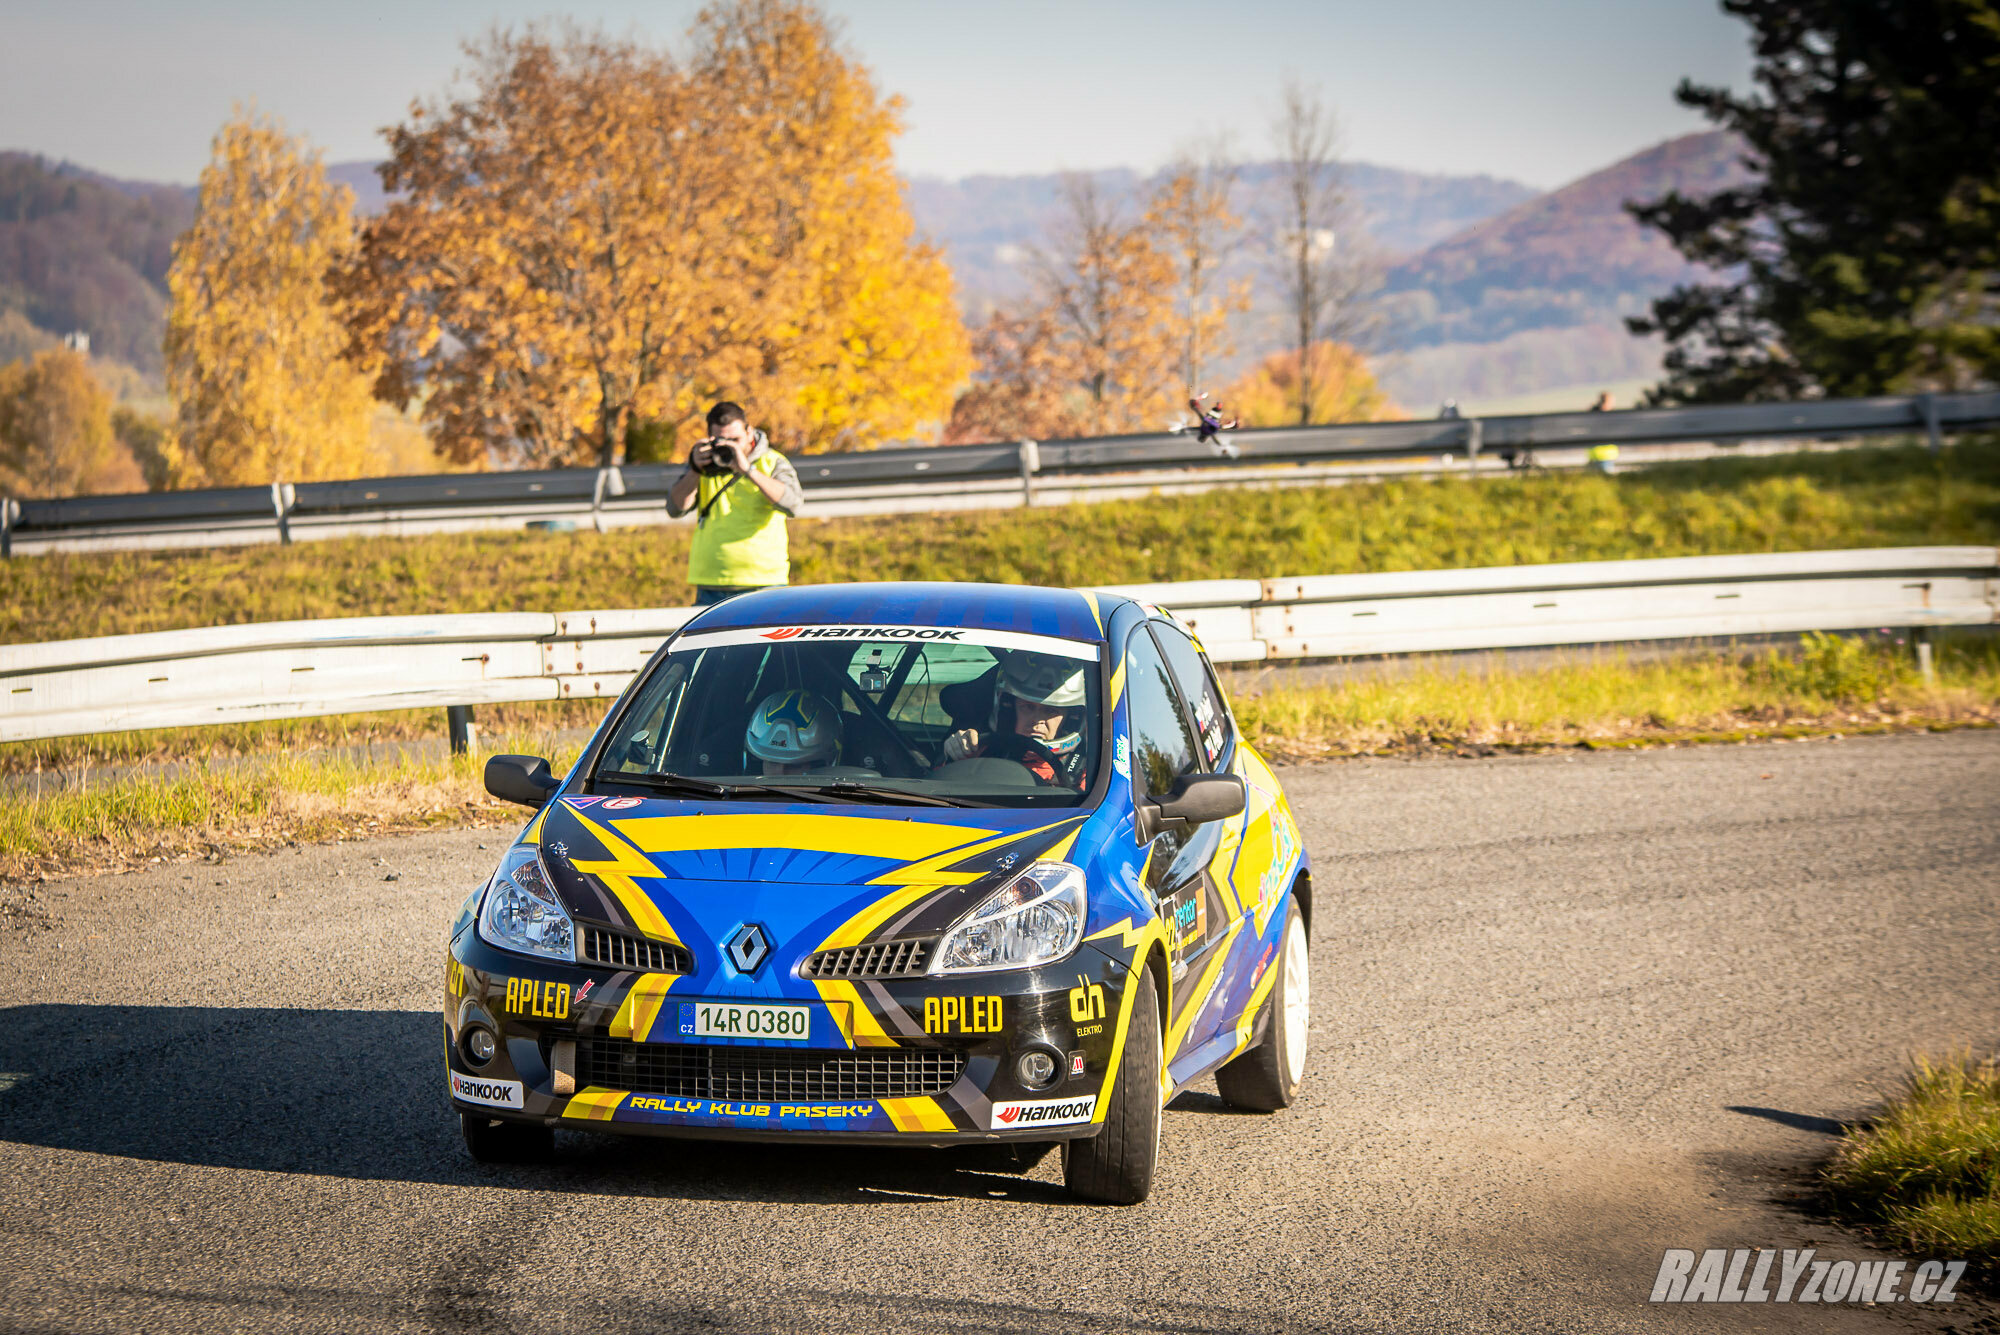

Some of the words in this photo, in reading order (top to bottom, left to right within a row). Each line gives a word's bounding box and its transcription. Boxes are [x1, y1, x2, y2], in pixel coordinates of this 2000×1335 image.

[505, 976, 571, 1020] APLED
[701, 1007, 742, 1033] 14R
[746, 1009, 805, 1035] 0380
[924, 995, 1003, 1034] APLED
[680, 1024, 694, 1034] CZ
[1076, 1024, 1103, 1037] ELEKTRO
[629, 1096, 702, 1113] RALLY
[709, 1102, 770, 1117] KLUB
[779, 1105, 873, 1118] PASEKY
